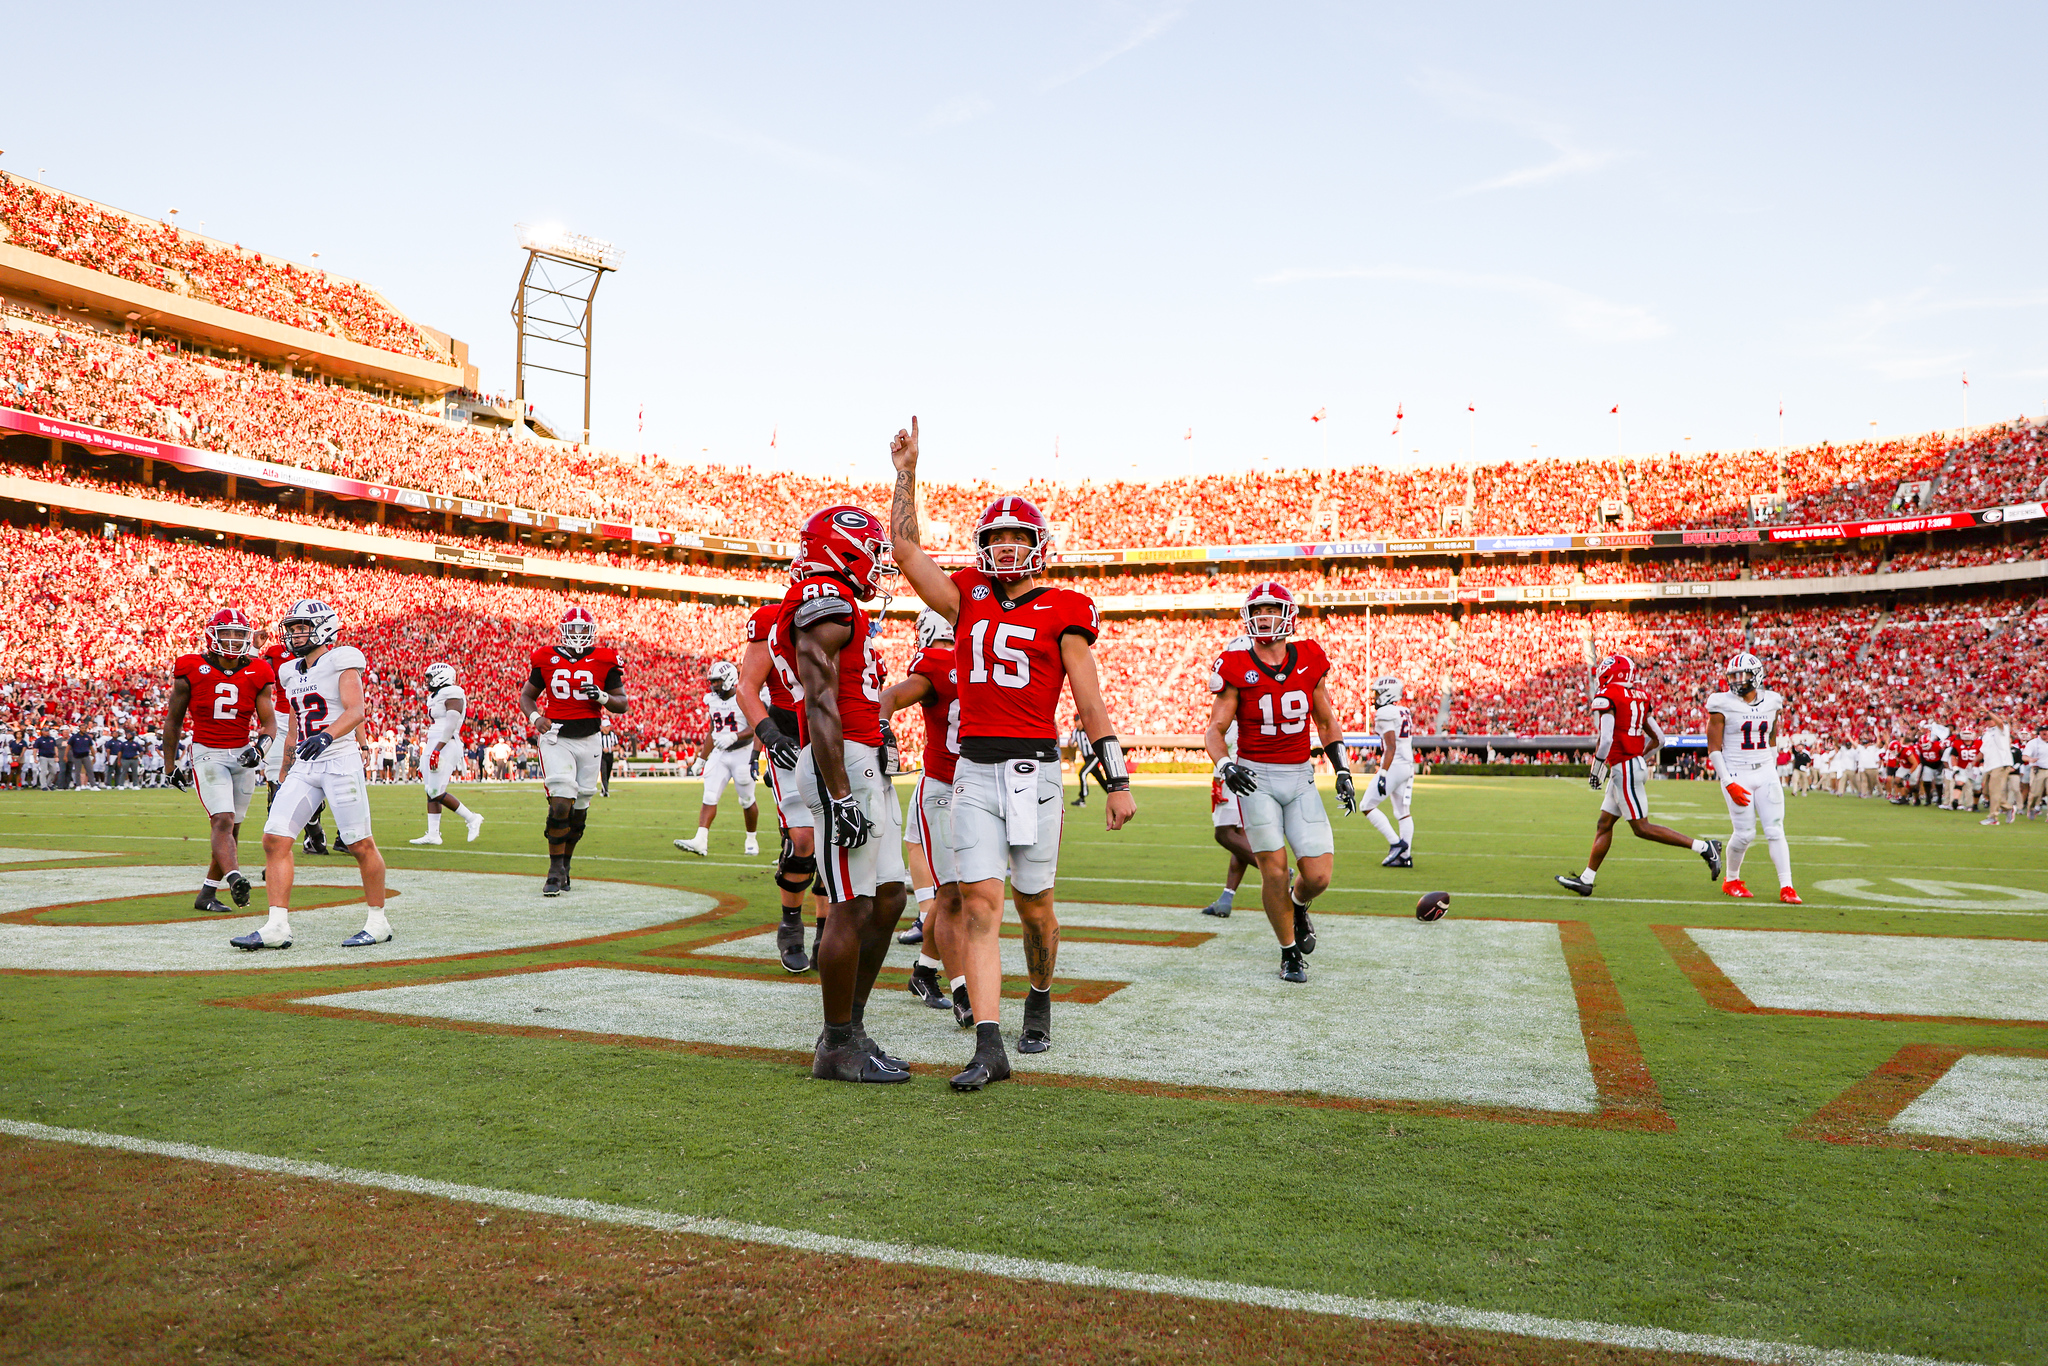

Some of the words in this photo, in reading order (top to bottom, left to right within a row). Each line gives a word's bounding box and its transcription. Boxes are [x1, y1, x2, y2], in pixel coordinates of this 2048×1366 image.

[39, 422, 50, 432] You
[51, 424, 60, 434] do
[60, 427, 74, 437] your
[75, 430, 92, 442] thing.
[93, 434, 111, 445] We've
[112, 437, 122, 448] got
[123, 440, 134, 450] you
[135, 443, 159, 455] covered.
[262, 468, 279, 479] Alfa
[280, 471, 320, 486] Insurance
[383, 488, 389, 500] 7
[436, 497, 442, 509] 0
[833, 511, 868, 528] G
[1773, 527, 1840, 539] VOLLEYBALL
[1867, 523, 1885, 533] ARMY
[1885, 522, 1902, 532] THUR
[1903, 520, 1920, 530] SEPT
[1920, 519, 1926, 529] 7
[1927, 517, 1952, 528] 7:30PM
[1505, 539, 1536, 548] Invesco
[1604, 534, 1655, 546] SEATGEEK
[1683, 530, 1760, 544] BULLDOGS
[1336, 543, 1377, 554] DELTA
[1389, 543, 1426, 551] NISSAN
[1433, 541, 1470, 550] NISSAN
[1138, 550, 1192, 560] CATERPILLAR
[803, 582, 840, 602] 86
[971, 585, 990, 600] SEC
[1664, 585, 1681, 595] 2021
[1691, 585, 1710, 595] 2022
[969, 619, 1037, 690] 15
[1211, 657, 1224, 674] 9
[1245, 671, 1259, 683] SEC
[291, 684, 318, 696] SKYHAWKS
[550, 668, 594, 701] 63
[213, 682, 240, 720] 2
[291, 692, 330, 744] 12
[1258, 689, 1310, 736] 19
[1627, 700, 1646, 737] 11
[1399, 719, 1413, 738] 2
[1741, 720, 1768, 750] 11
[1961, 749, 1977, 761] 85
[864, 768, 874, 778] G
[1013, 762, 1035, 774] G
